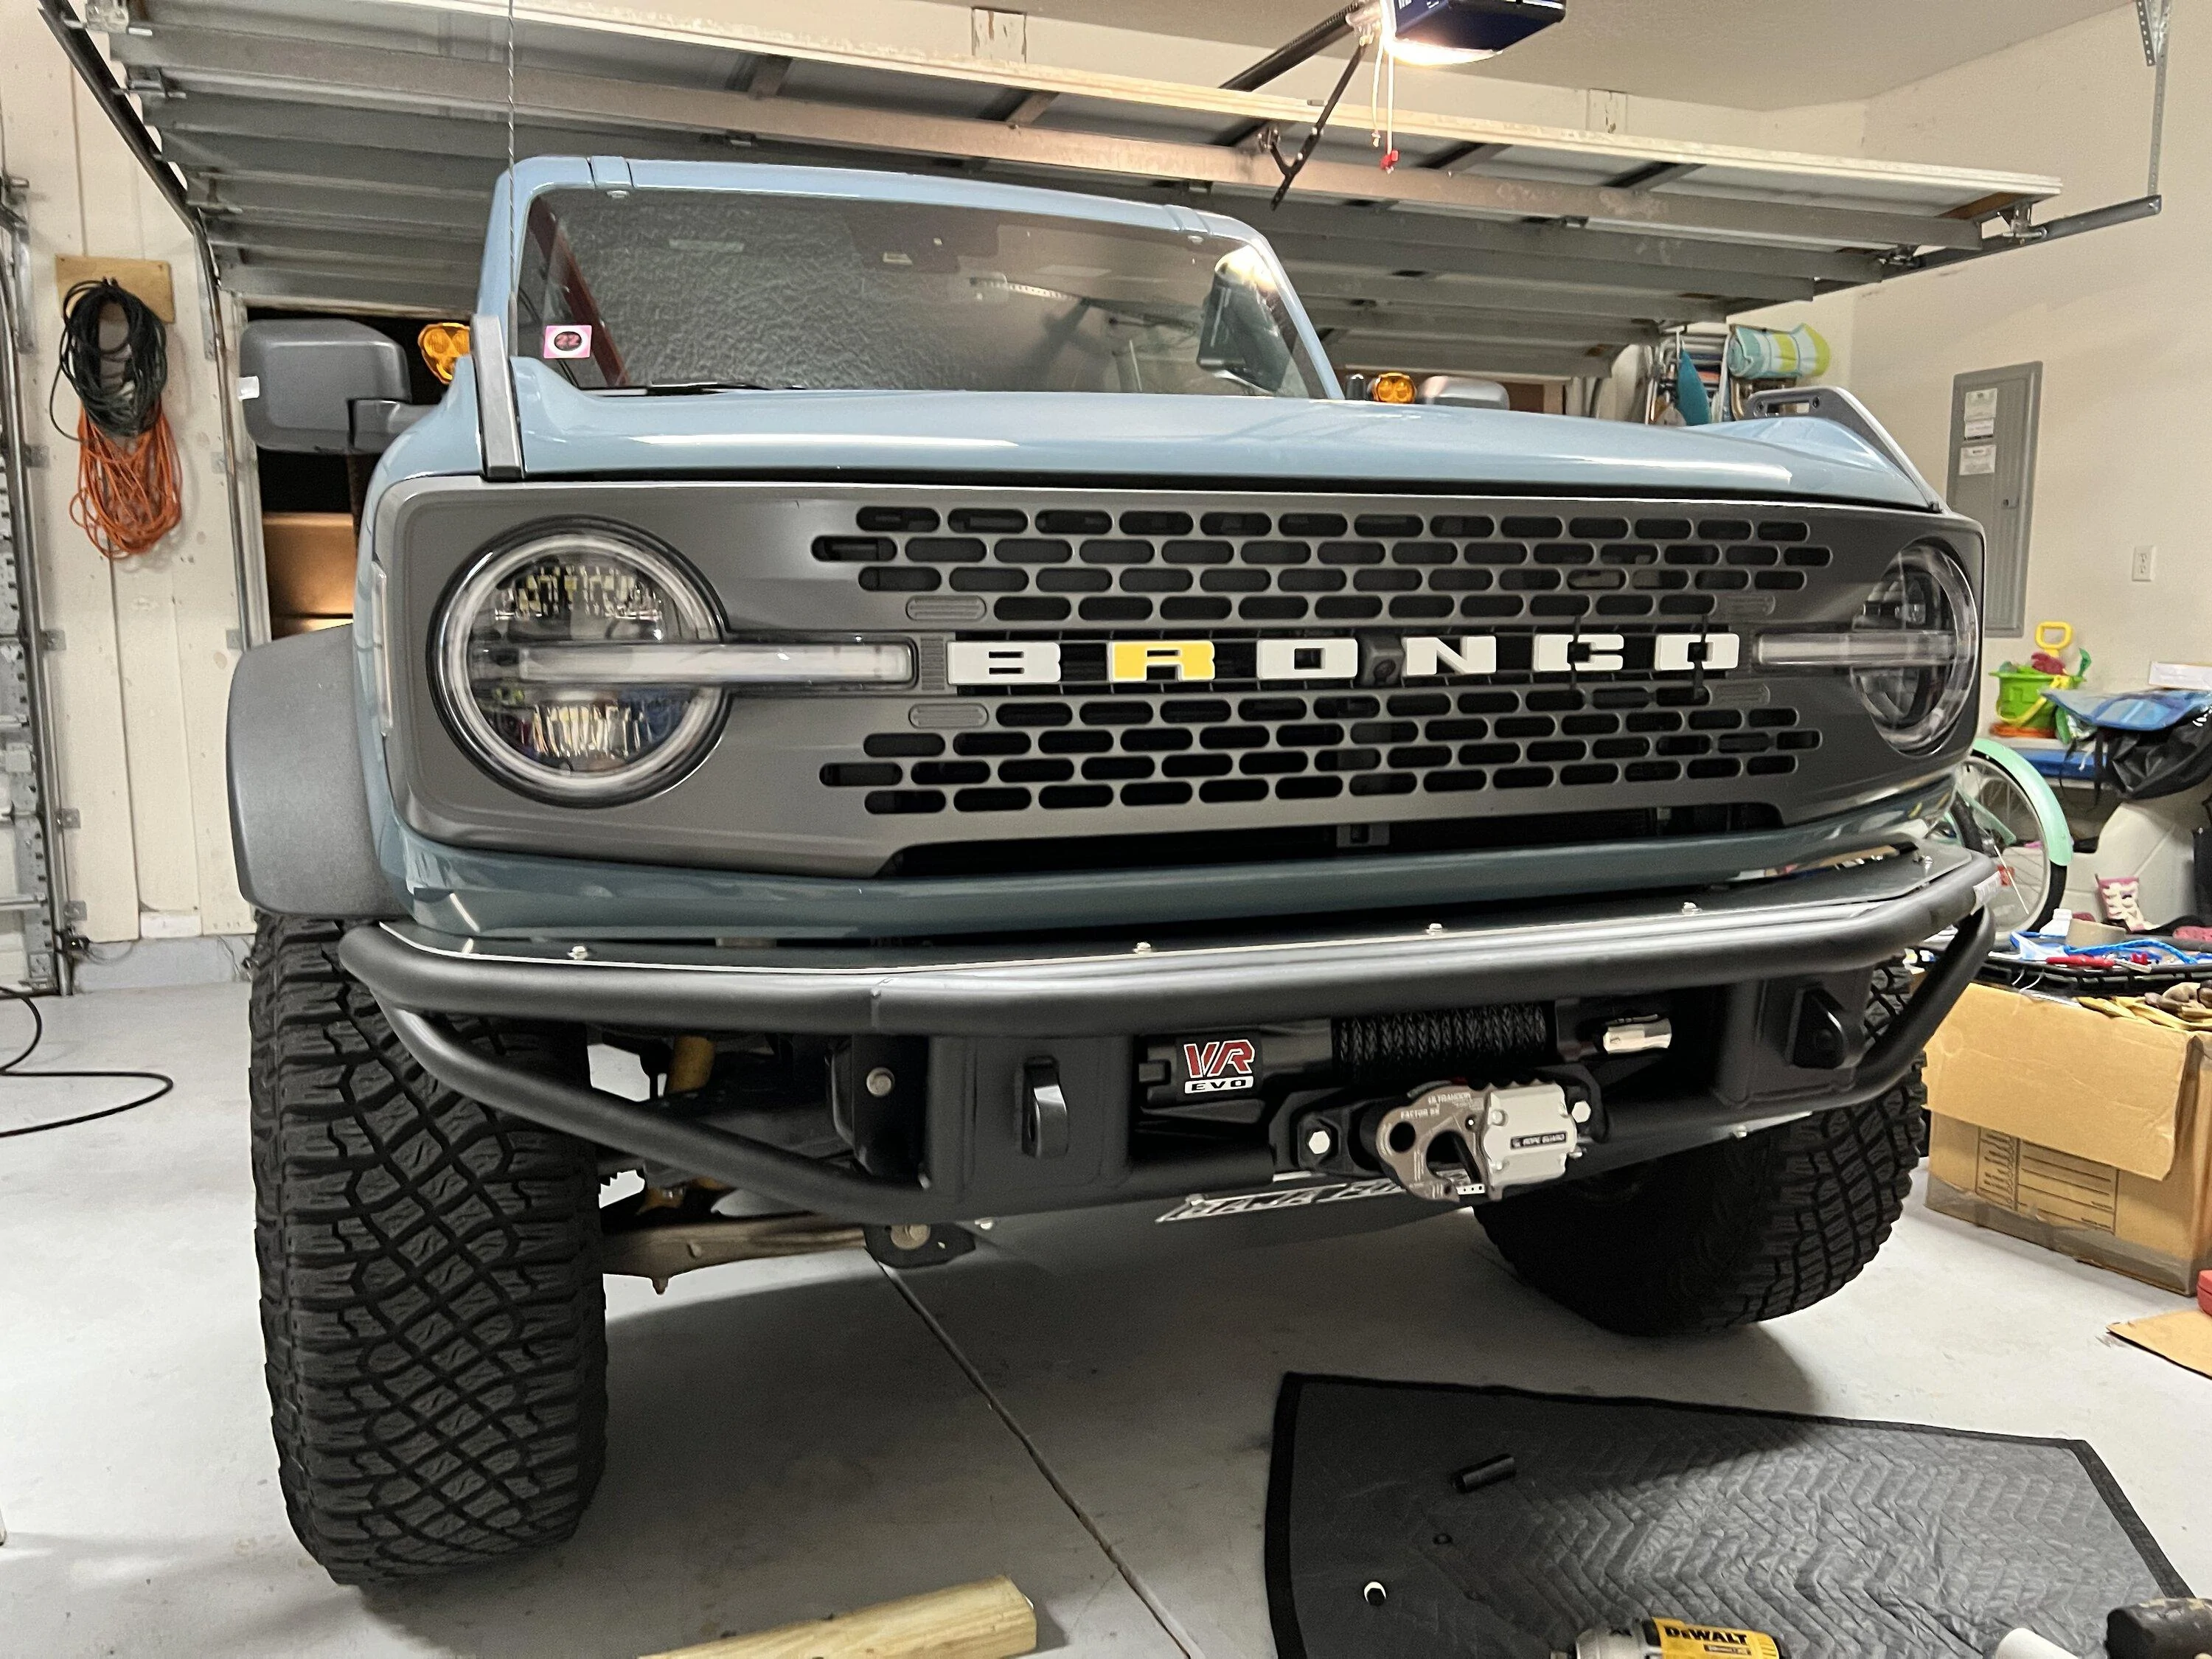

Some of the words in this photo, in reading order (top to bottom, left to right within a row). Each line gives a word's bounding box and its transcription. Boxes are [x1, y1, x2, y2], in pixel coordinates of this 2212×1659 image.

[947, 632, 1740, 686] BRONCO
[1183, 1039, 1255, 1079] VR
[1192, 1079, 1246, 1091] EVO
